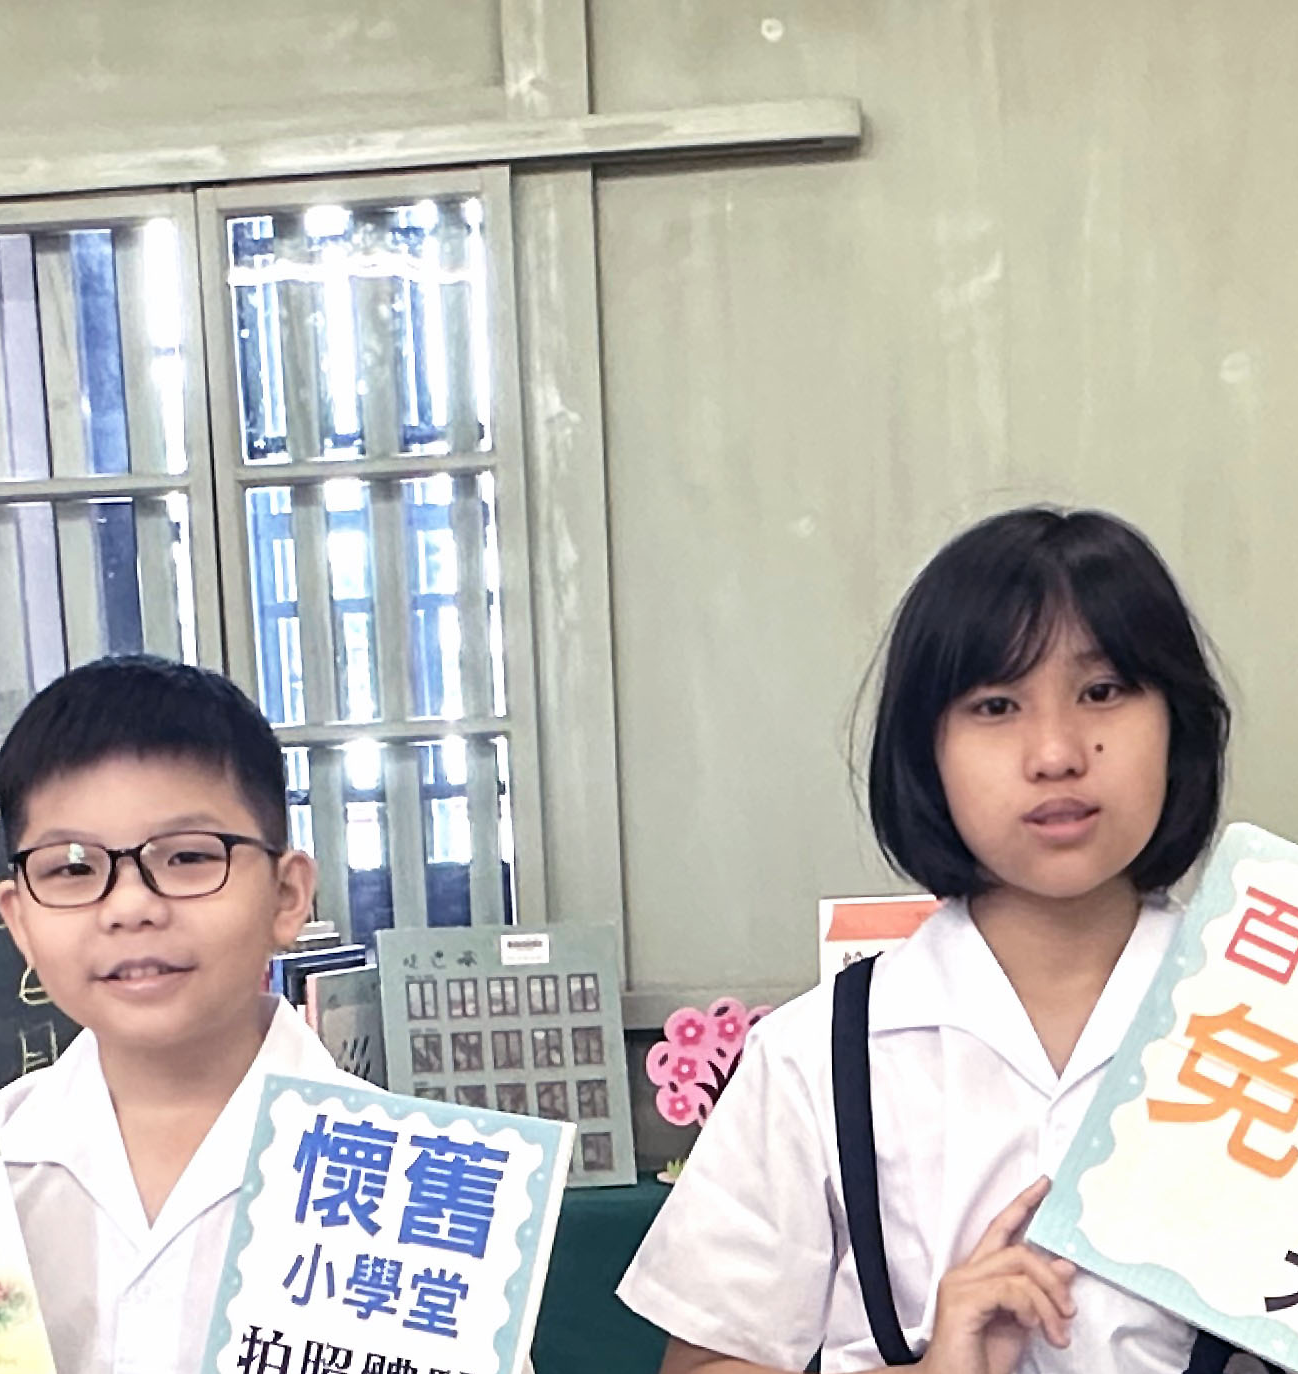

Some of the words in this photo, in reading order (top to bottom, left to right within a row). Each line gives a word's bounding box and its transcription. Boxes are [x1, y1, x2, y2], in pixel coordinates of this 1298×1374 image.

[293, 1113, 510, 1260] 懷舊
[281, 1243, 470, 1339] 小學堂
